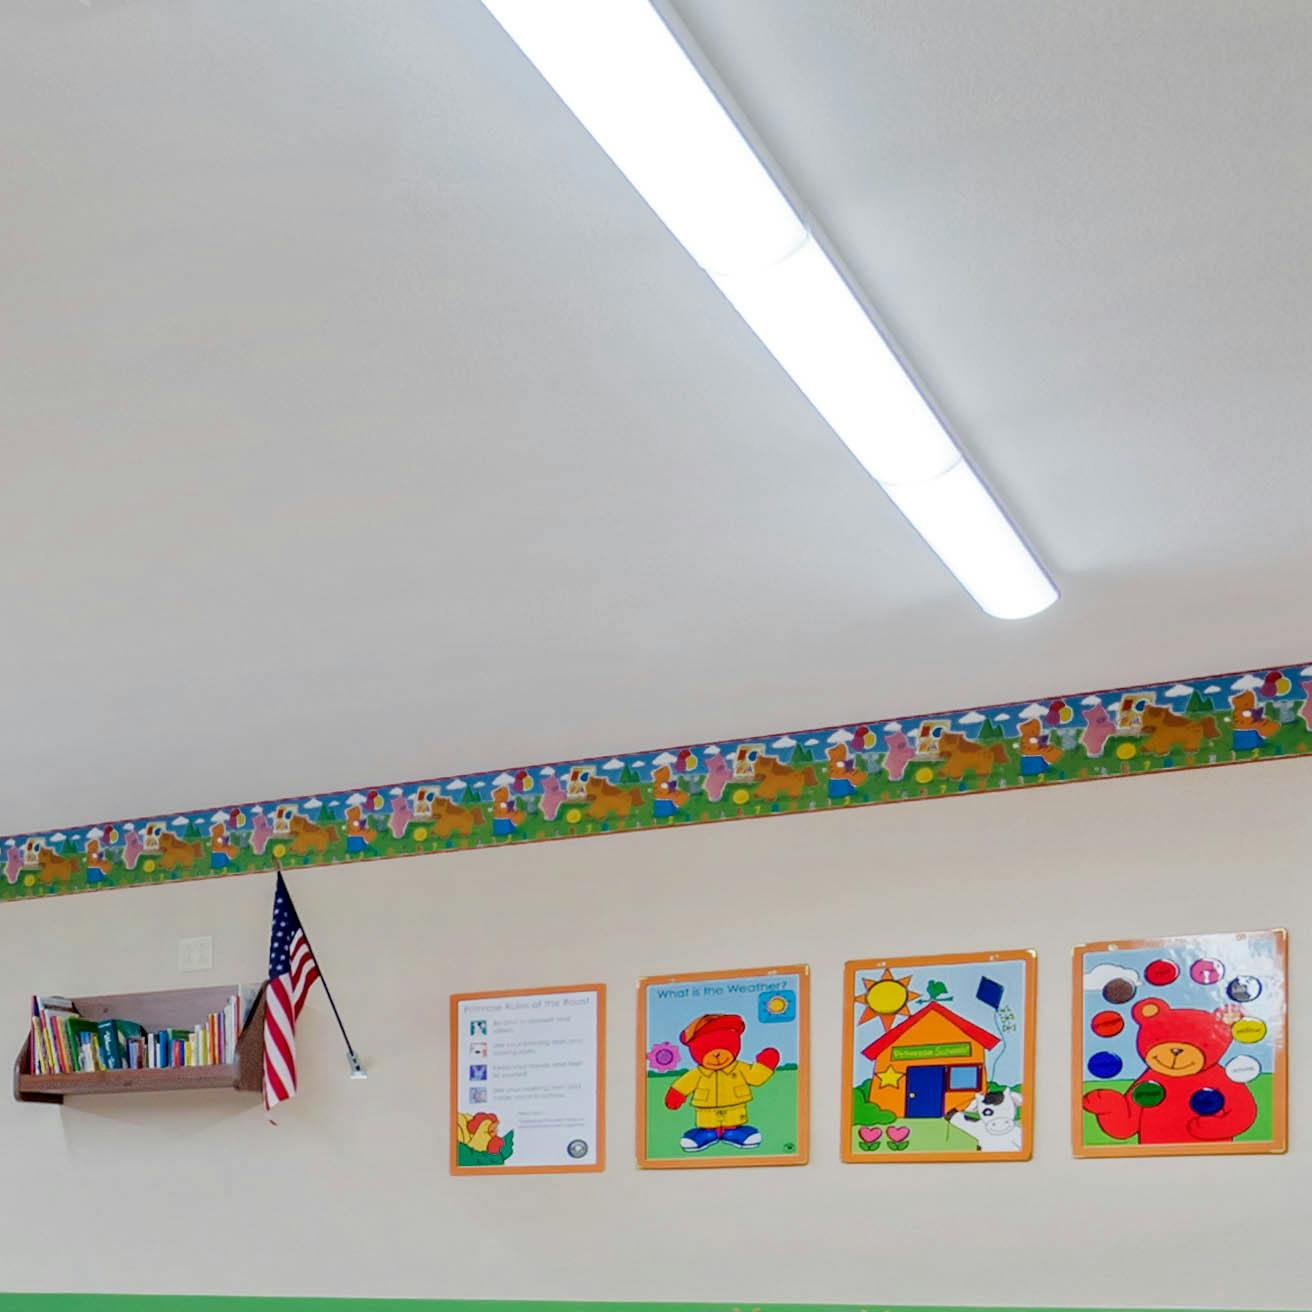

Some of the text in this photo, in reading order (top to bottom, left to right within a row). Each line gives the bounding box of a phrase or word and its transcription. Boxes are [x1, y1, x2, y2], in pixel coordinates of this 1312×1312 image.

[657, 980, 788, 1000] What is the Weather?
